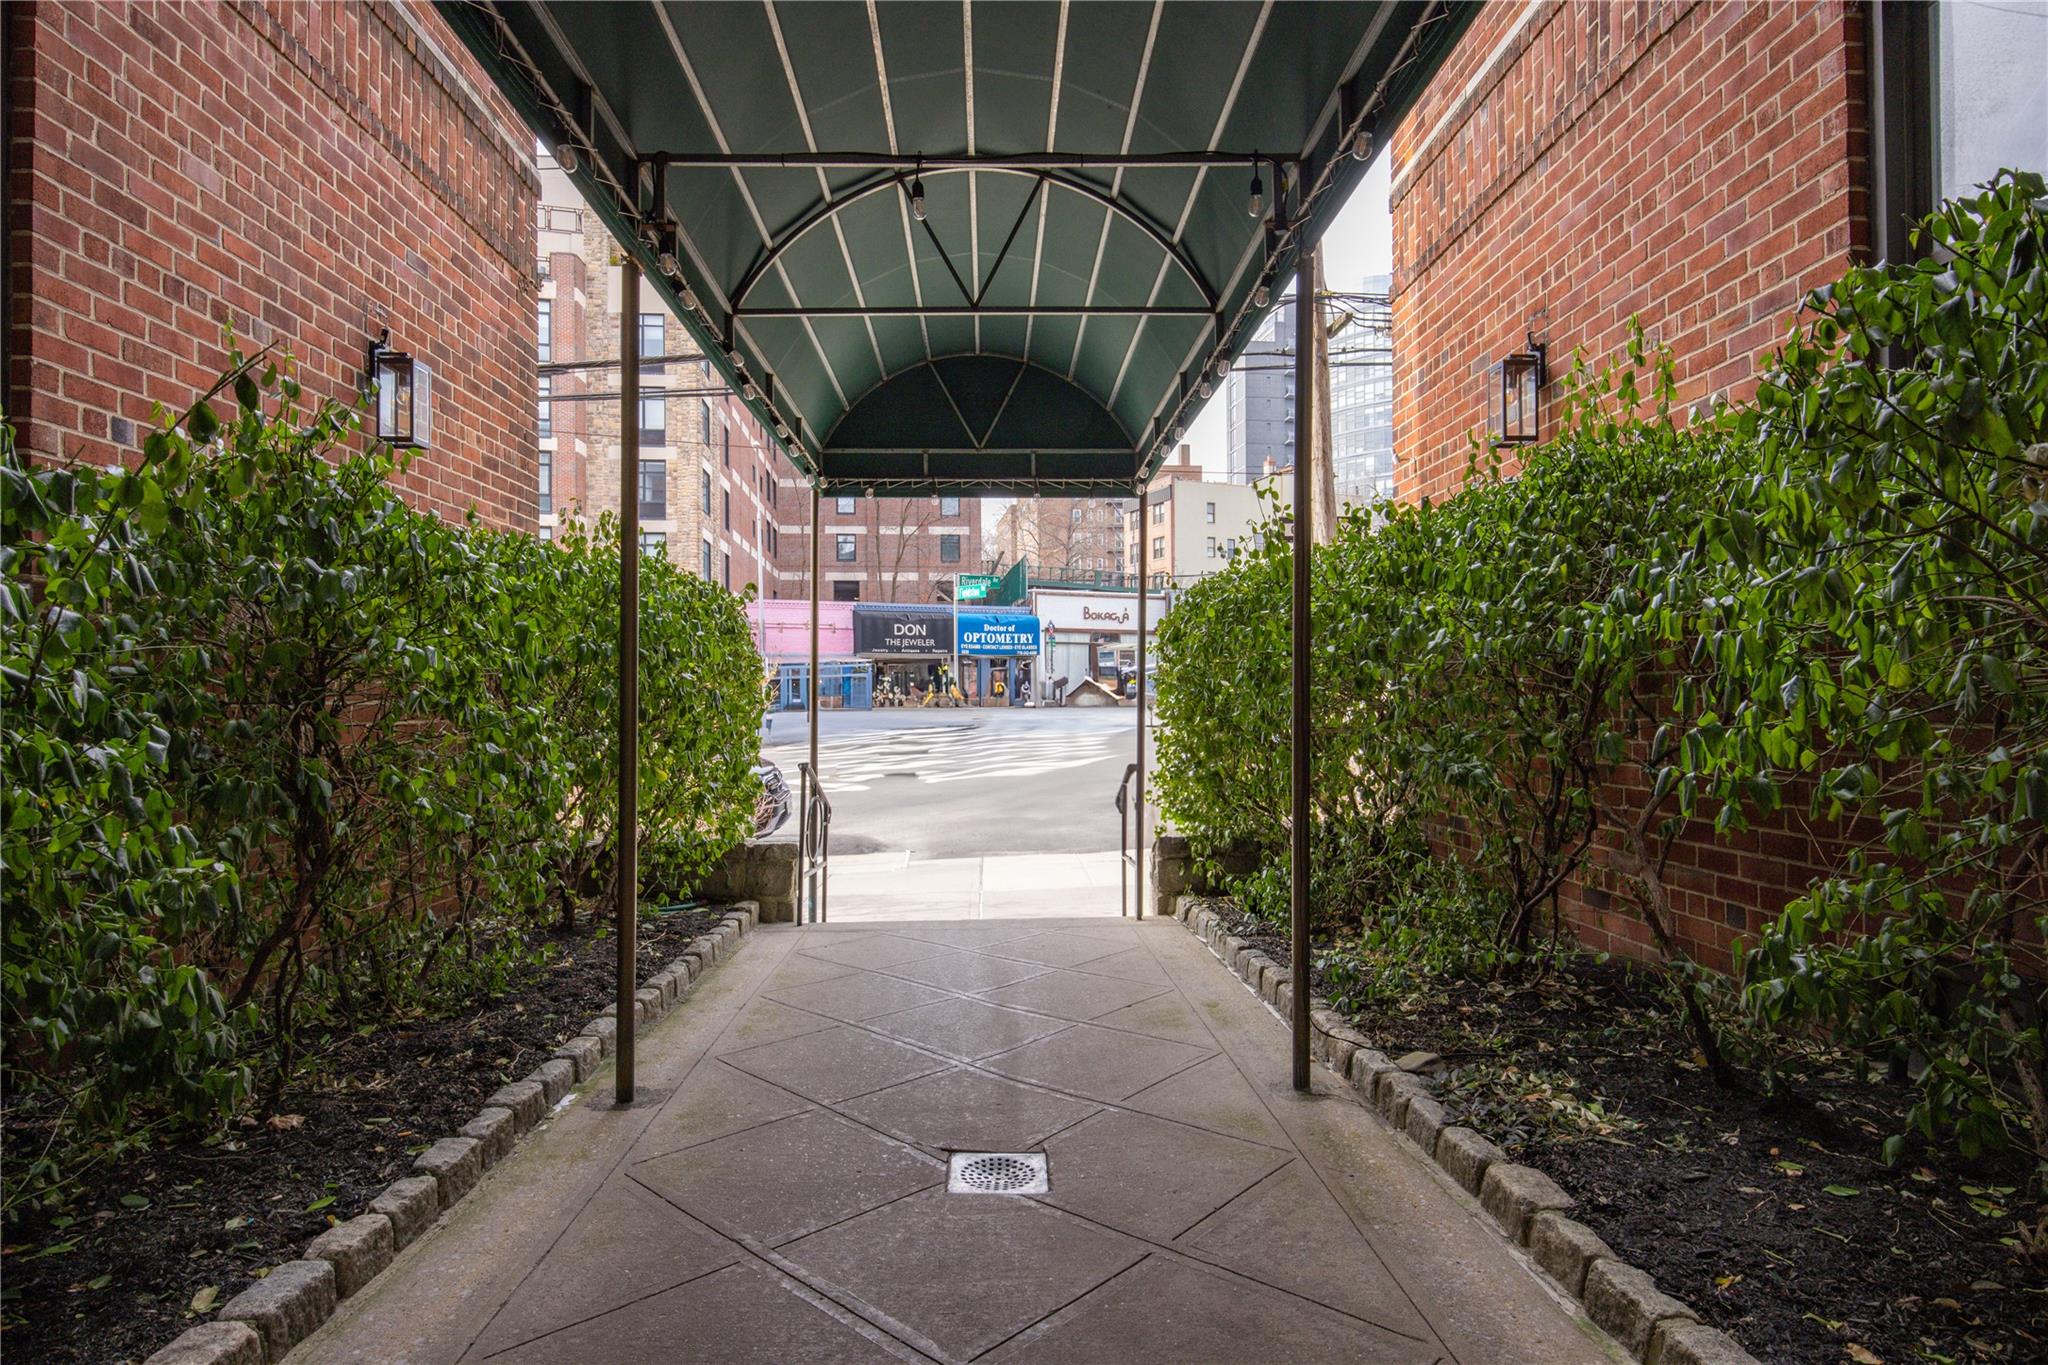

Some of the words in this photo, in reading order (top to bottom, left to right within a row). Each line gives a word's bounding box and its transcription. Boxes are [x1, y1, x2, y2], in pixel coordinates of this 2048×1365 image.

[961, 576, 991, 587] Riverdale
[894, 623, 927, 636] DON
[984, 624, 1007, 632] Doctor
[1007, 624, 1016, 632] of
[885, 638, 901, 646] THE
[901, 638, 935, 648] JEWELER
[963, 632, 1034, 644] OPTOMETRY
